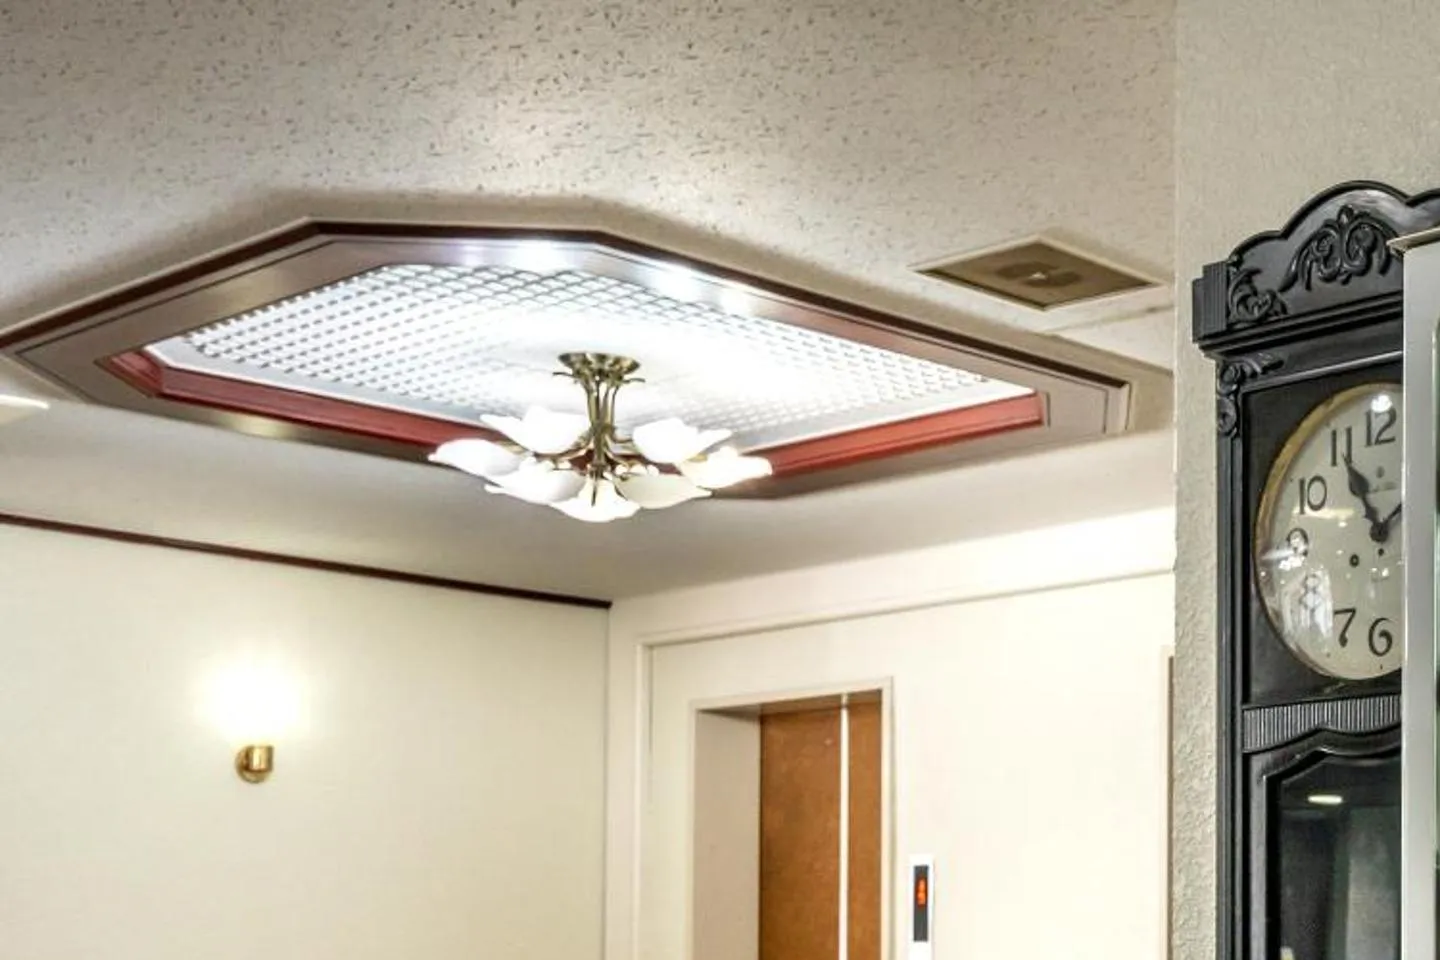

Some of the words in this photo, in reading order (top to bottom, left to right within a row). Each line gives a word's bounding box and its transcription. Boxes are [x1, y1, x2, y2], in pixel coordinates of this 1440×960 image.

[1330, 427, 1353, 466] 11
[1364, 408, 1396, 447] 12
[1299, 475, 1328, 515] 10
[1334, 607, 1356, 648] 7
[1368, 617, 1392, 657] 6
